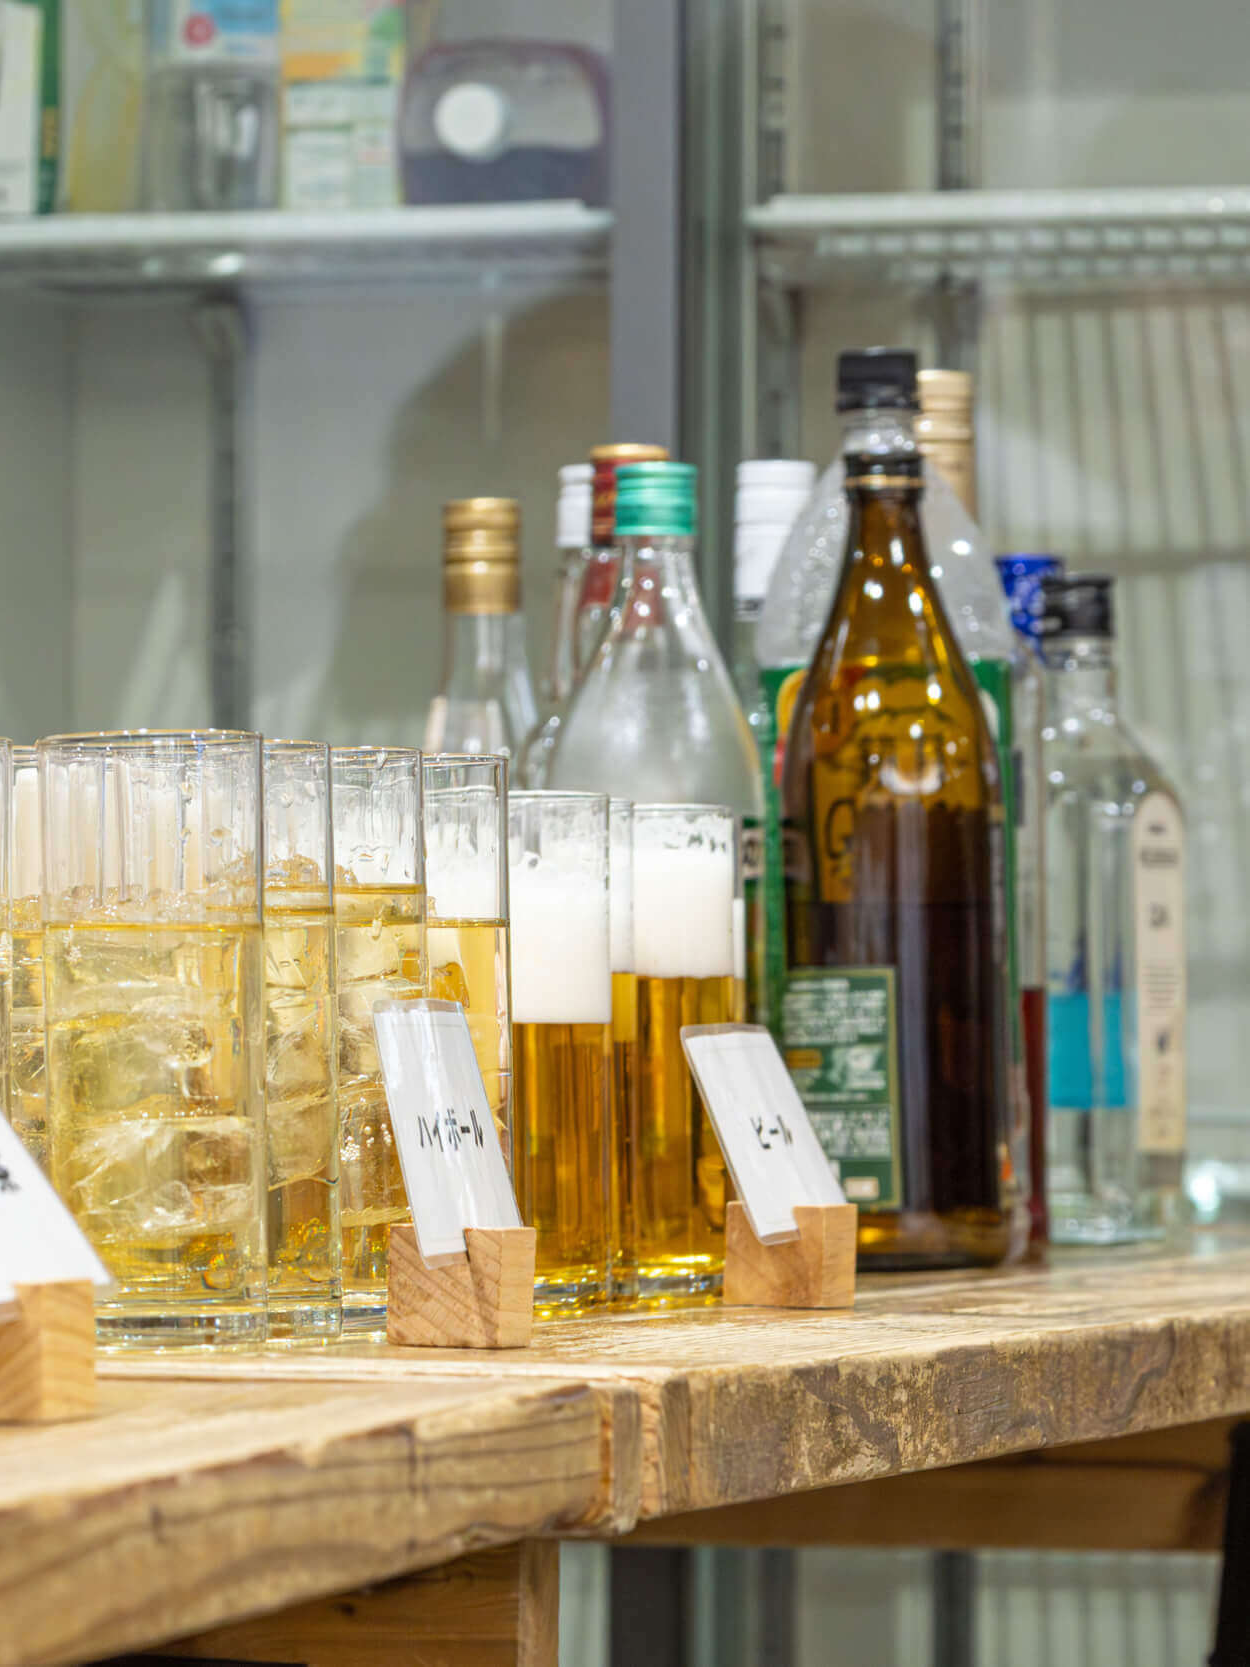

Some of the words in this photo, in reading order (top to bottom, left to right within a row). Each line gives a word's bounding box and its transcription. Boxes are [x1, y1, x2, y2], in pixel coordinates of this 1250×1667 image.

[416, 1107, 485, 1152] ハイボール
